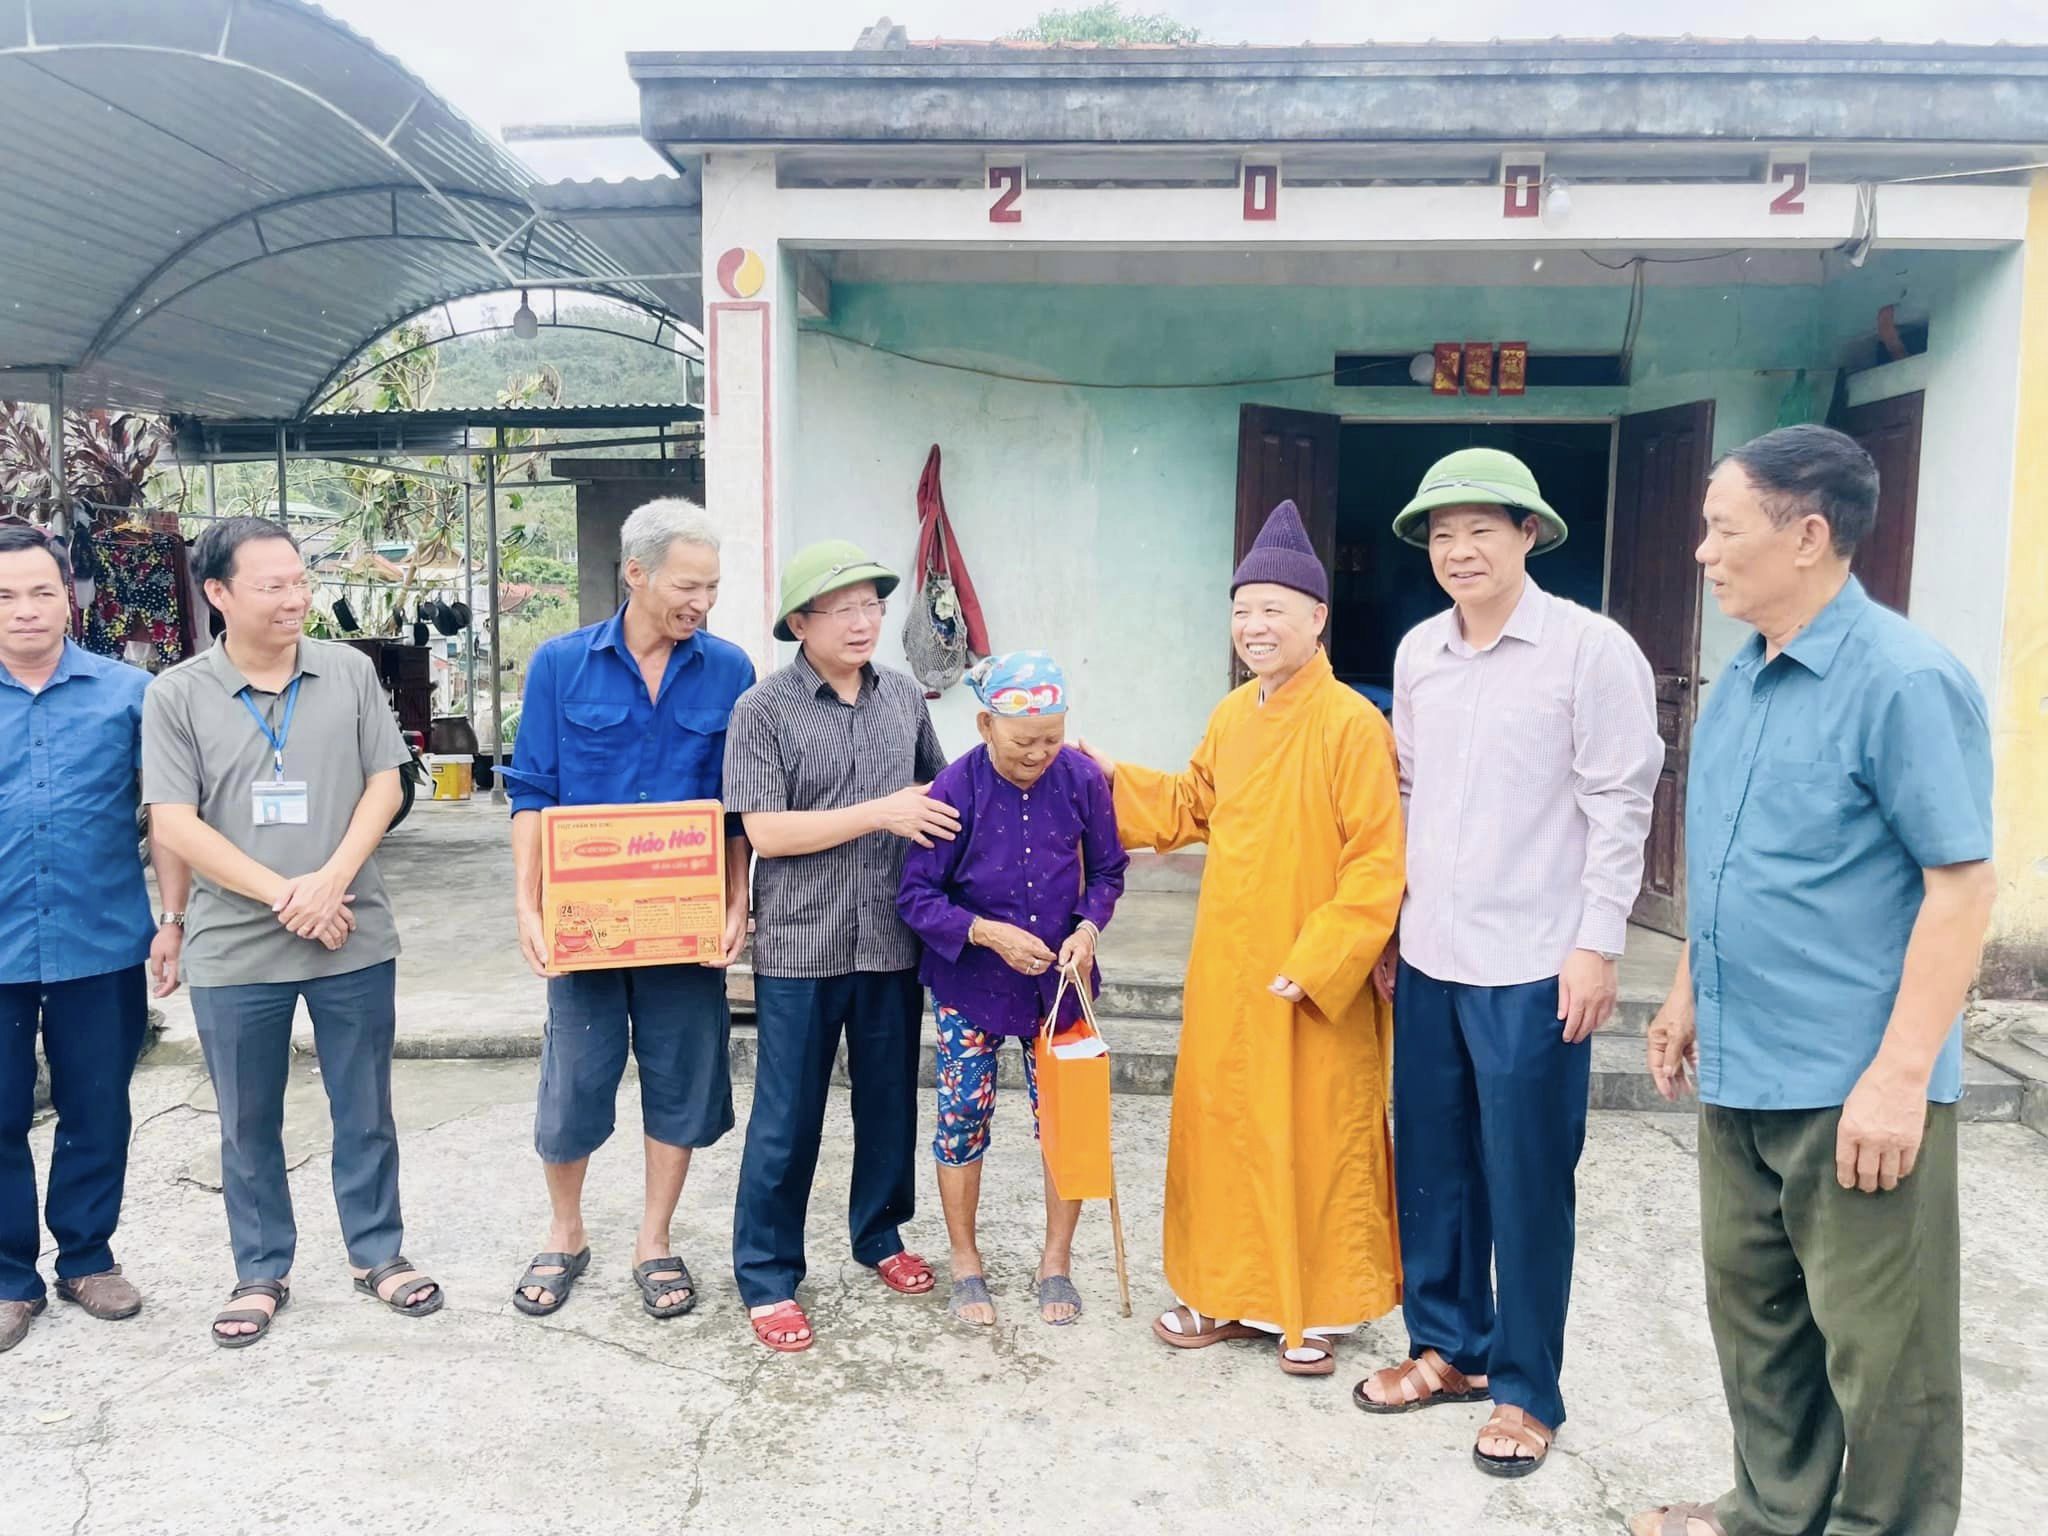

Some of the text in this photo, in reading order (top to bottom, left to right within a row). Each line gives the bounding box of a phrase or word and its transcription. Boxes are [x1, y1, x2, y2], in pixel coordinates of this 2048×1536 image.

[989, 162, 1806, 222] 2 0 0 2
[628, 831, 664, 855] Hảo
[669, 825, 706, 850] Hảo
